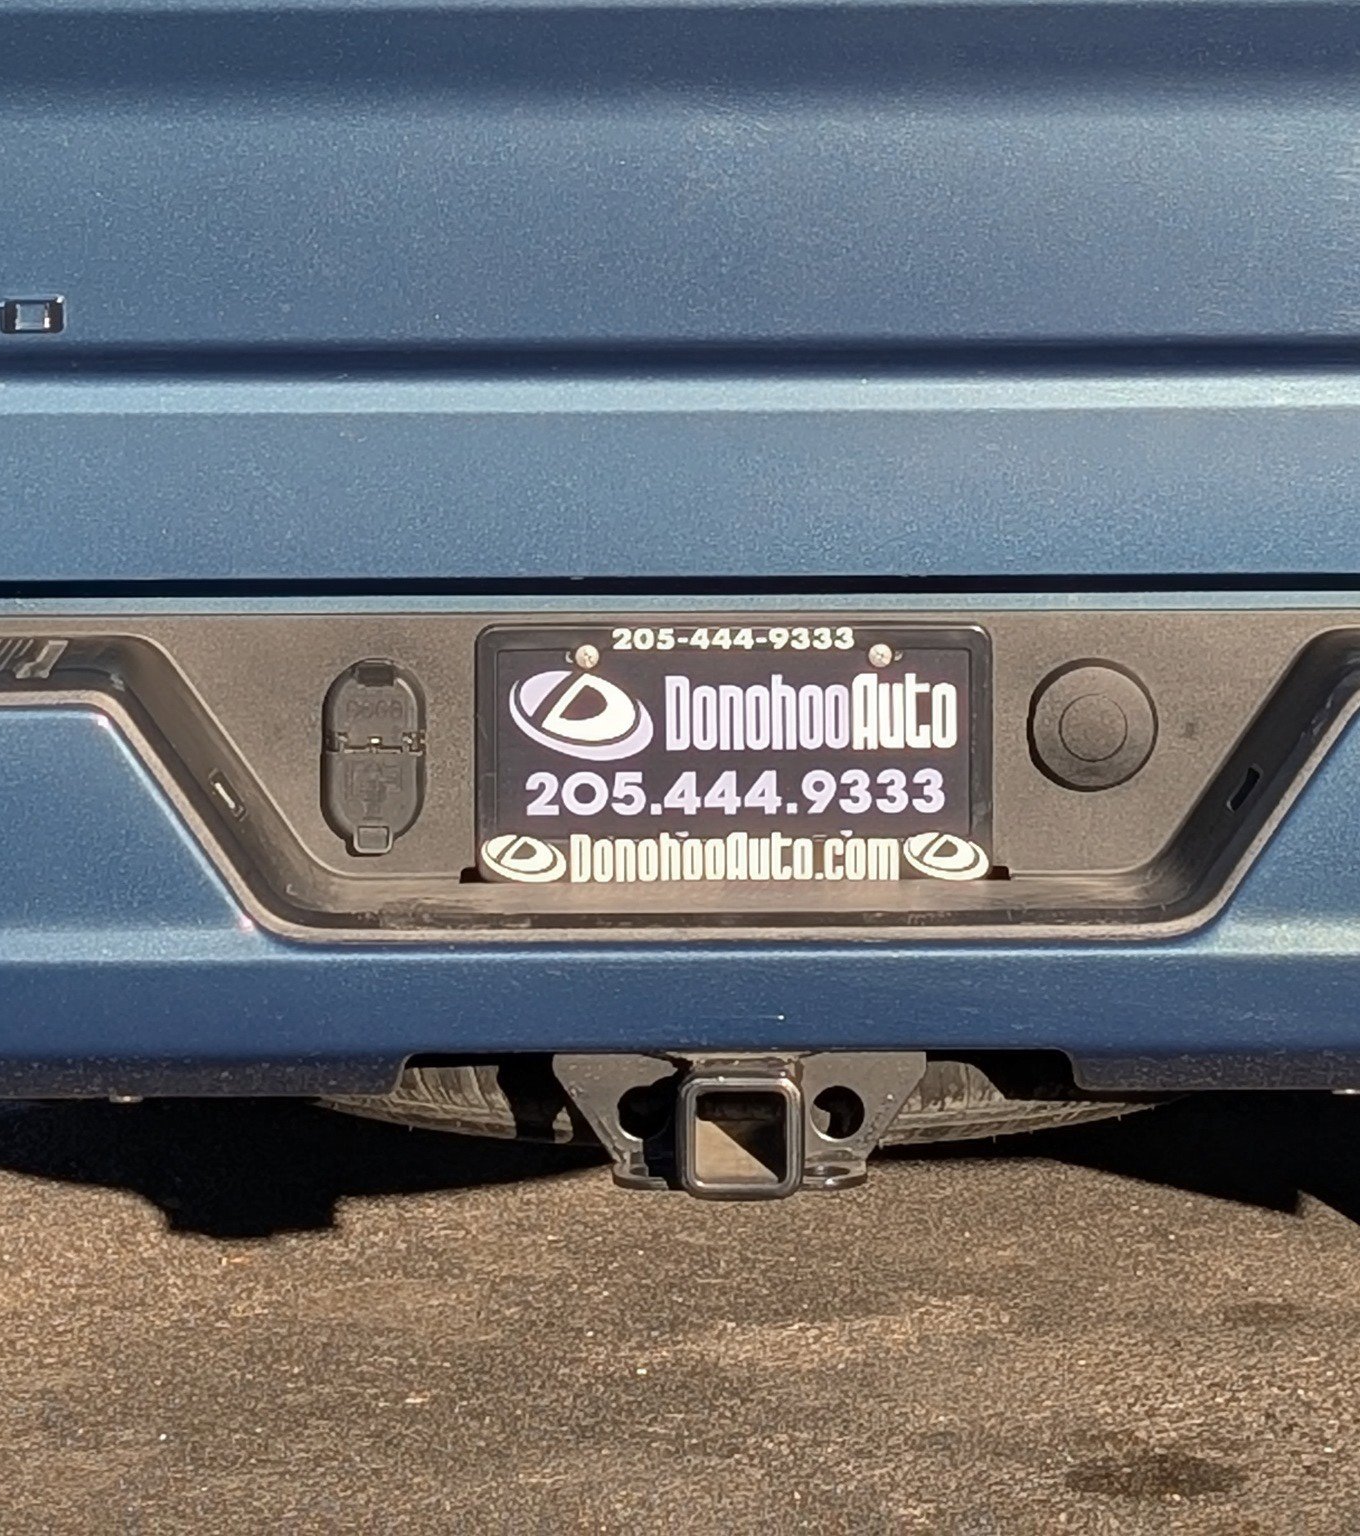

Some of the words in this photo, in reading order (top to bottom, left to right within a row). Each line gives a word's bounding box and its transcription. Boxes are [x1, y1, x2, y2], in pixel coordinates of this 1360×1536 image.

[611, 627, 856, 650] 205-444-9333
[664, 672, 958, 751] DonohooAuto
[525, 768, 946, 816] 205.444.9333
[569, 831, 900, 883] DonohooAuto.com
